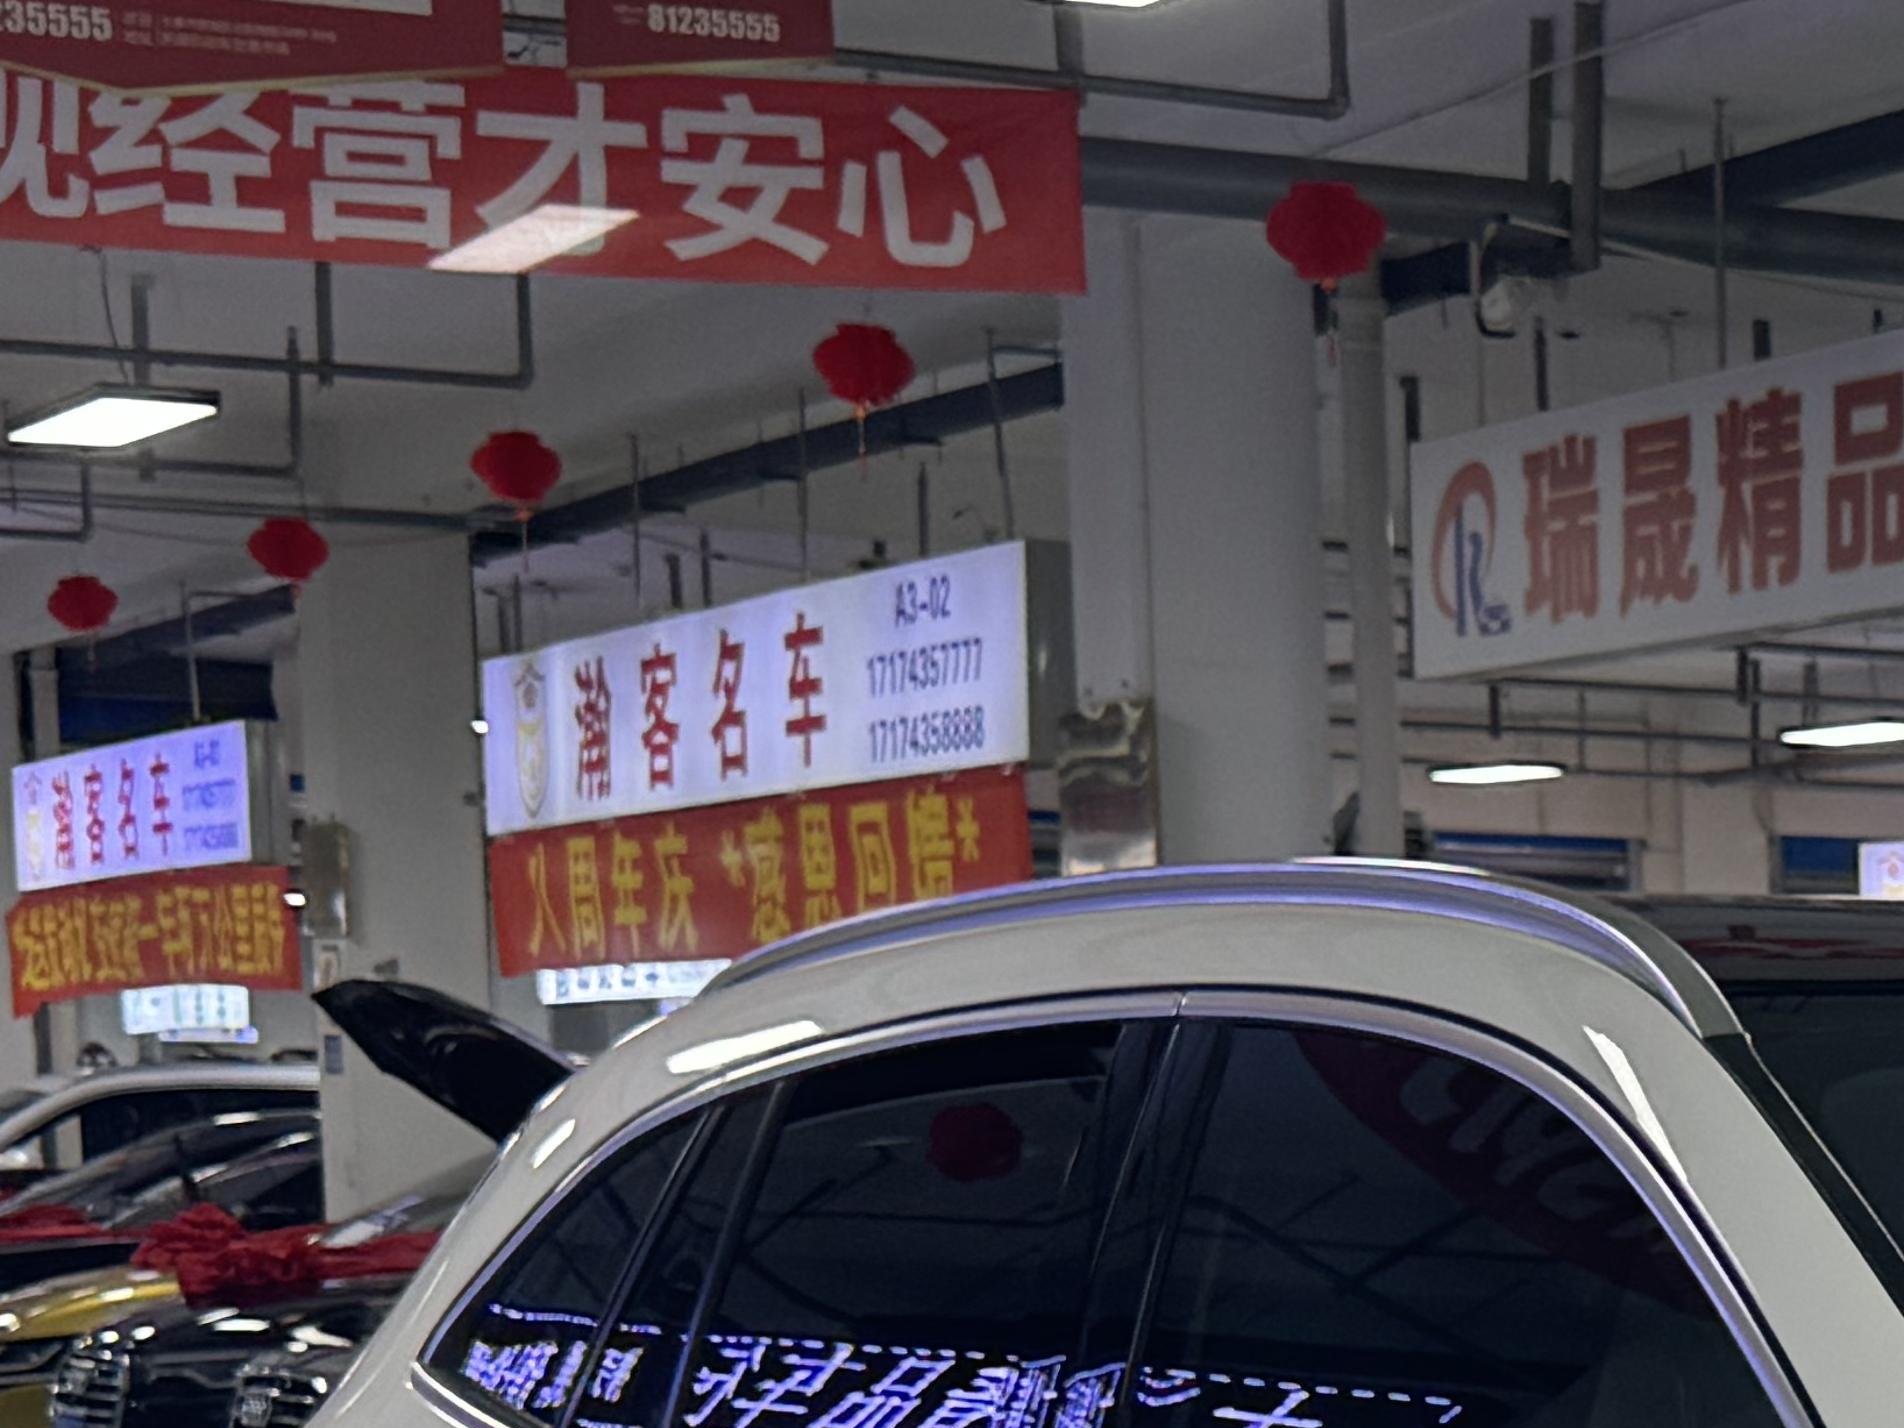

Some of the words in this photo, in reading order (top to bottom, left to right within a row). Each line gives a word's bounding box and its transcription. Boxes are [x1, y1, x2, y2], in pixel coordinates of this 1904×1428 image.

[0, 0, 112, 41] 35555
[647, 4, 780, 43] 81235555
[895, 574, 952, 629] A3-02
[867, 637, 983, 698] 17174357777
[574, 610, 827, 801] 瀚客名车
